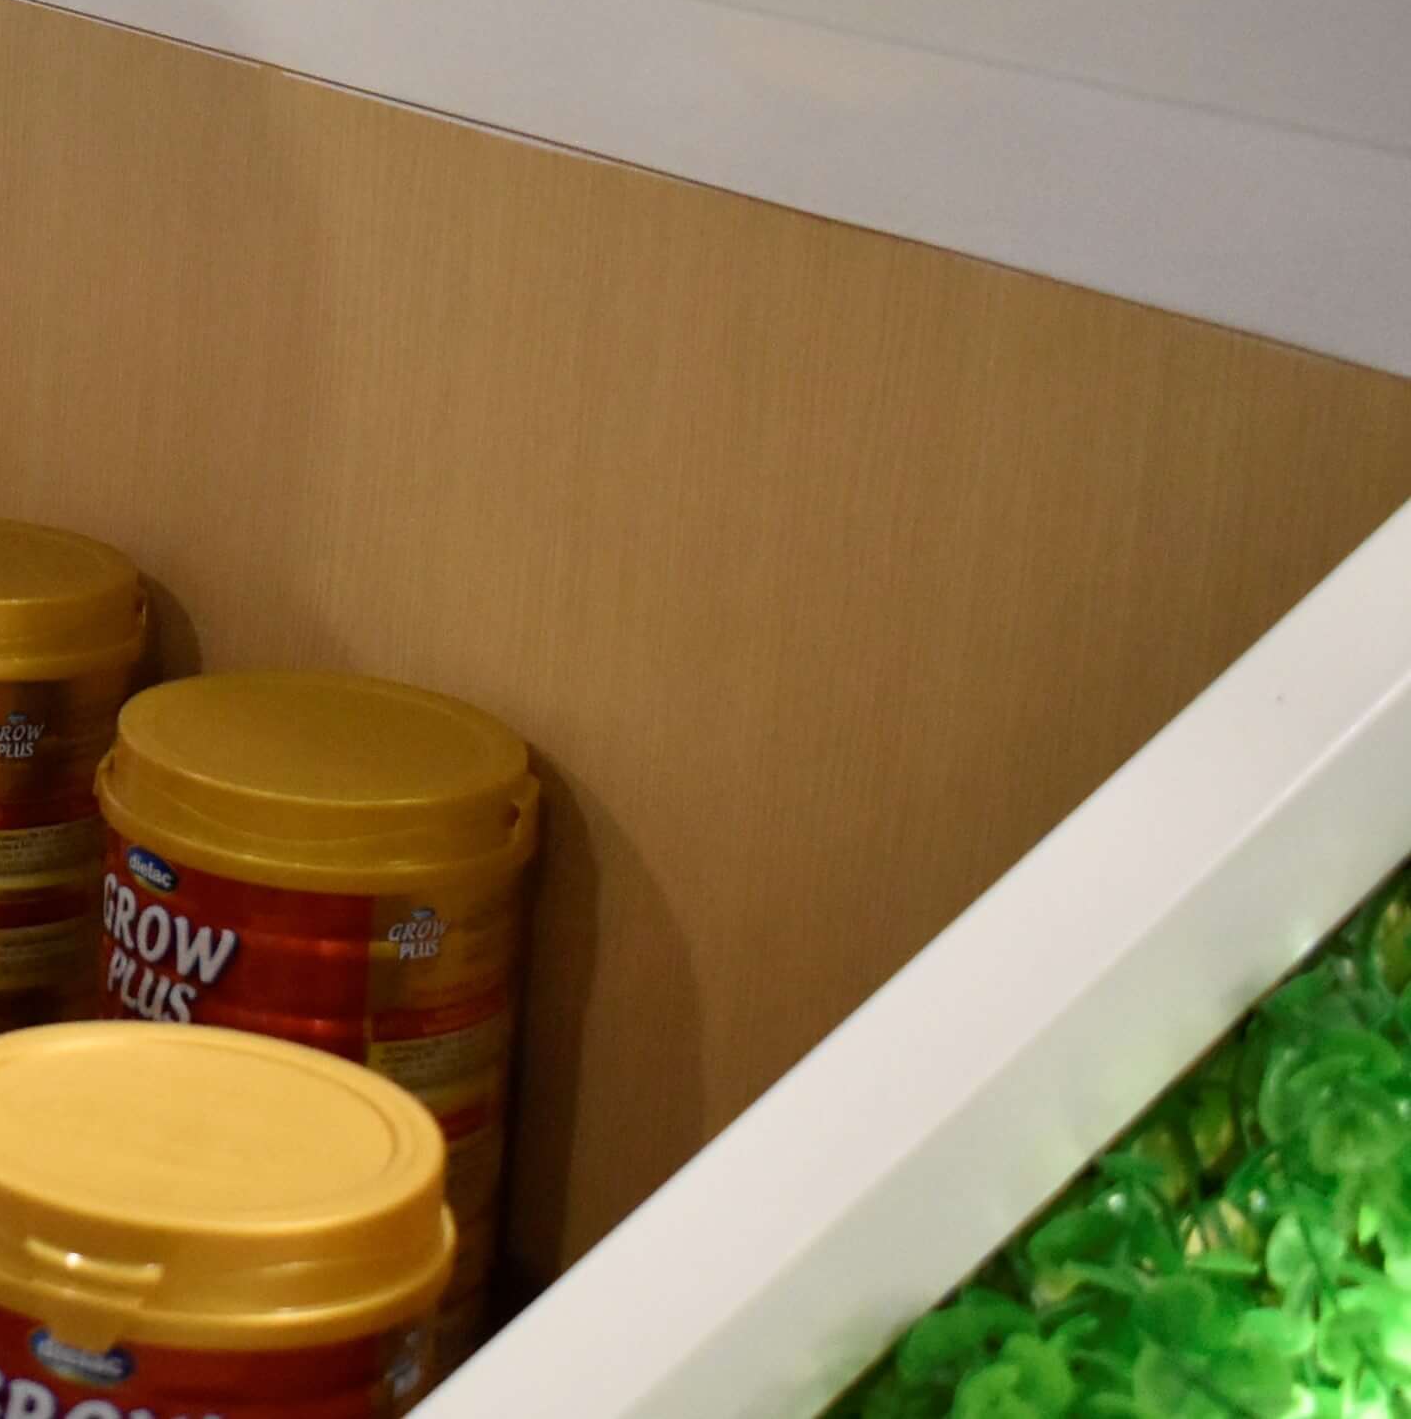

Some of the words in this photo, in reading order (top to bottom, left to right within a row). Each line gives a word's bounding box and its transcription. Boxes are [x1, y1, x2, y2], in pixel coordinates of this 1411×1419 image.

[128, 852, 174, 888] dielac
[103, 873, 239, 985] GROW
[387, 917, 451, 944] GROW
[398, 938, 440, 961] PLUS
[107, 946, 198, 1024] PLUS
